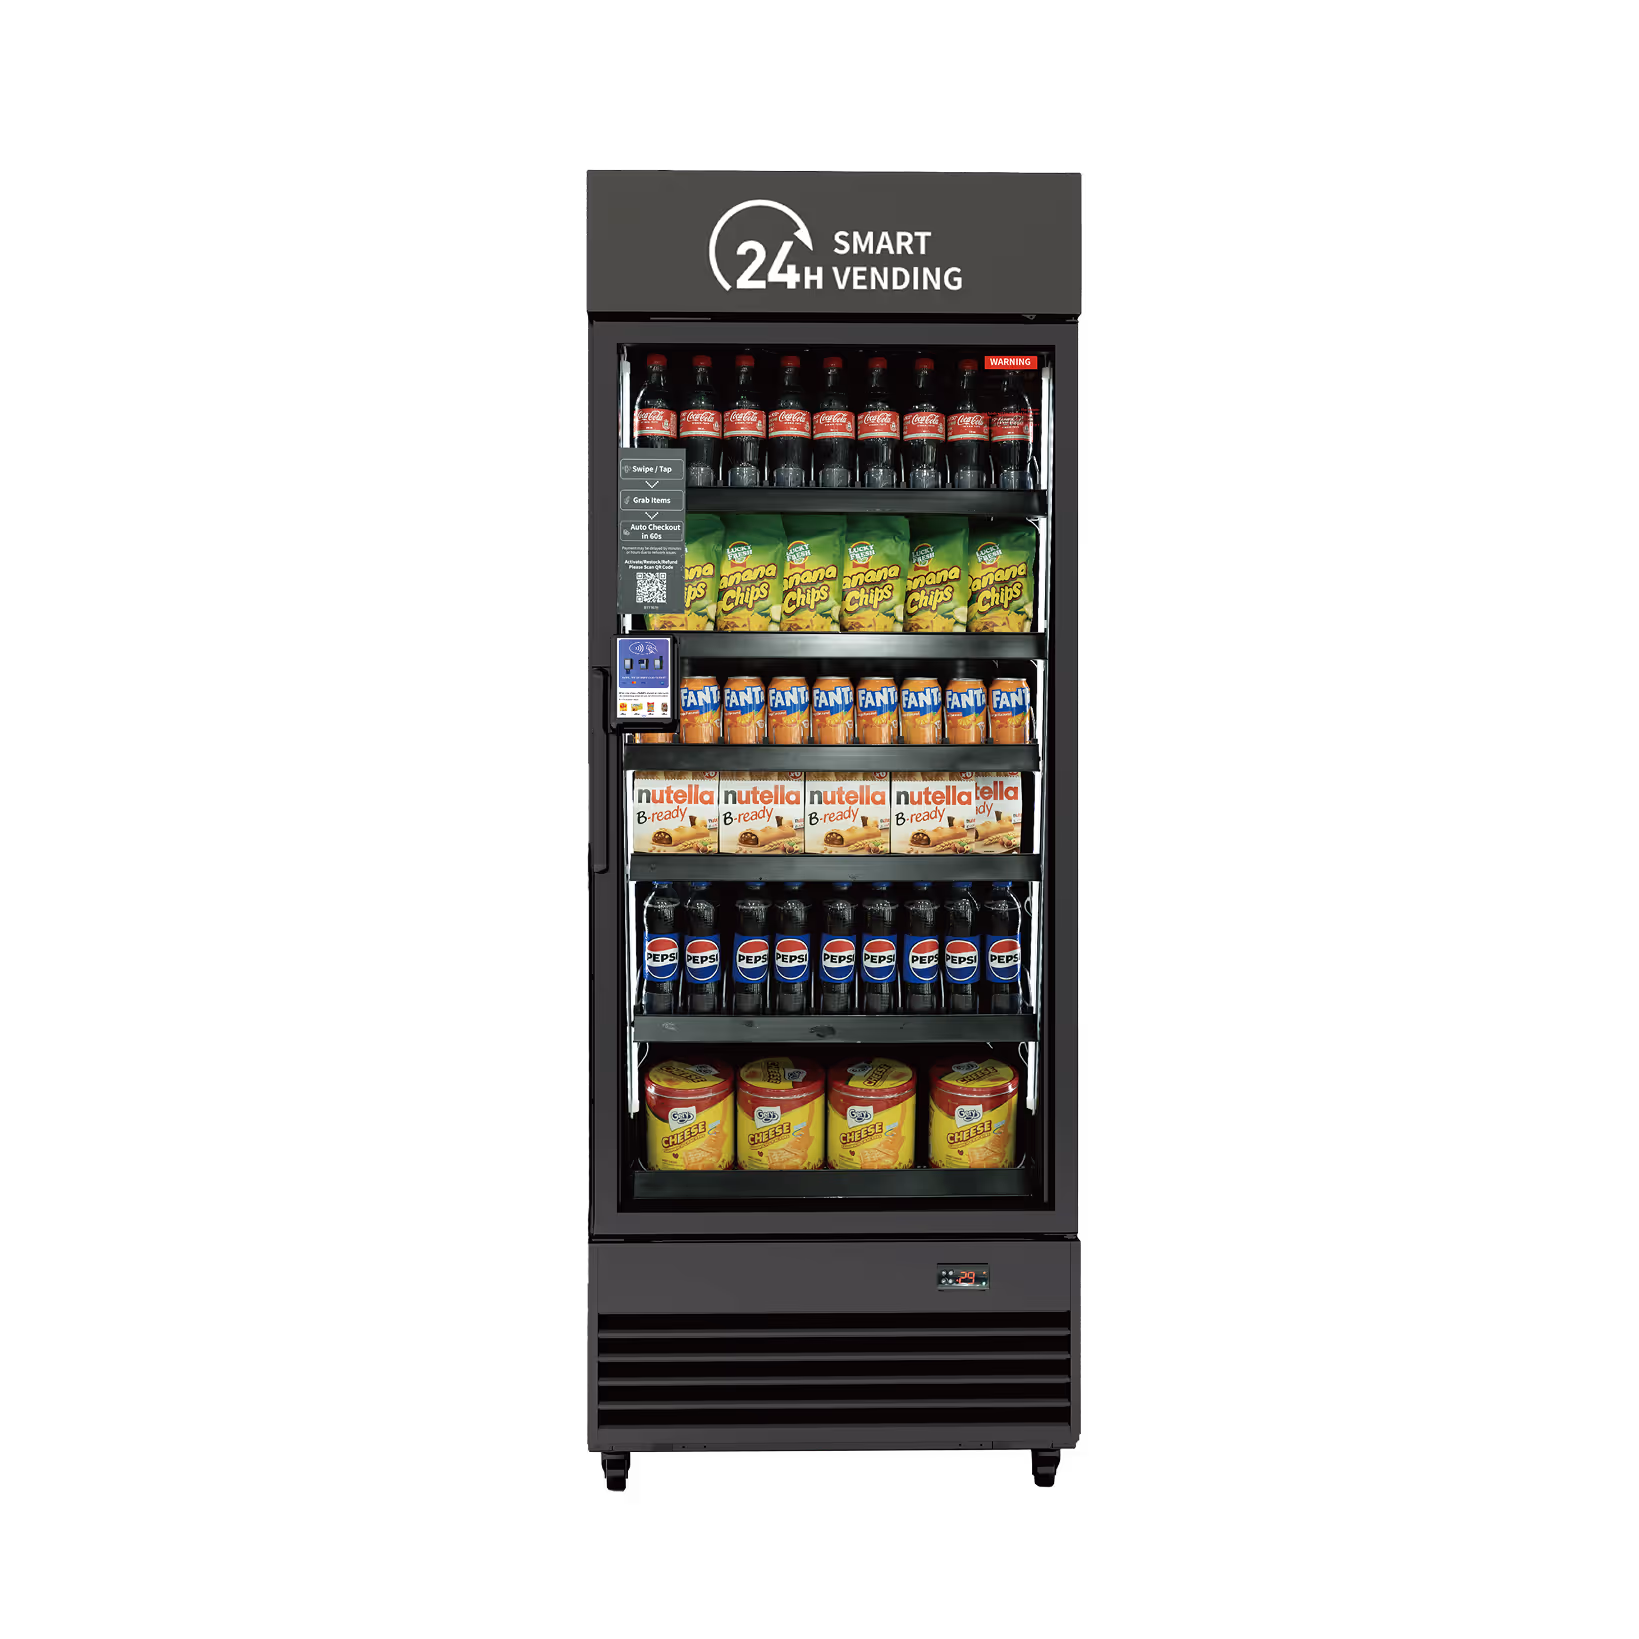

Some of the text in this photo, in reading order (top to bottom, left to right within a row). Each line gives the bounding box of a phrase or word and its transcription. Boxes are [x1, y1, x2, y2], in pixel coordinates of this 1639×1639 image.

[834, 231, 932, 255] SMART
[832, 266, 963, 290] VENDING
[989, 357, 1031, 366] WARNING
[632, 465, 654, 474] Swipe
[659, 465, 672, 474] Tap
[633, 496, 650, 504] Grab
[630, 523, 681, 531] Auto Checkout
[727, 545, 751, 556] LUCKY
[728, 549, 752, 561] FRESH
[786, 544, 809, 555] LUCKY
[787, 550, 811, 562] FRESH
[848, 544, 874, 554] LUCKY
[850, 550, 875, 561] FRESH
[912, 546, 934, 557] LUCKY
[913, 552, 935, 563] FRESH
[976, 544, 1000, 555] LUCKY
[977, 550, 1002, 562] FRESH
[720, 564, 777, 590] anana
[783, 566, 837, 591] anana
[842, 565, 900, 590] anana
[907, 566, 960, 590] anana
[685, 583, 706, 608] ips
[722, 583, 769, 612] Chips
[783, 585, 829, 614] Chips
[844, 585, 893, 614] Chips
[907, 586, 953, 614] Chips
[977, 582, 1022, 614] Chips
[680, 686, 720, 707] FANT
[858, 687, 897, 708] FANT
[992, 688, 1029, 709] FANT
[638, 784, 714, 805] nutella
[724, 784, 800, 805] nutella
[810, 785, 886, 805] nutella
[896, 785, 972, 805] nutella
[975, 781, 1018, 801] tella
[637, 806, 687, 824] B-ready
[723, 806, 773, 825] B-ready
[808, 806, 859, 826] B-ready
[895, 806, 945, 826] B-ready
[647, 952, 678, 962] PEPSI
[687, 954, 718, 964] PEPSI
[738, 954, 767, 964] PEPS
[776, 953, 807, 963] PEPSI
[823, 953, 855, 963] PEPSI
[864, 953, 895, 964] PEPSI
[911, 954, 939, 964] PEPS
[946, 954, 977, 964] PEPSI
[662, 1121, 706, 1148] CHEESE
[748, 1122, 791, 1145] CHEESE
[839, 1121, 883, 1145] CHEESE
[947, 1120, 992, 1144] CHEESE
